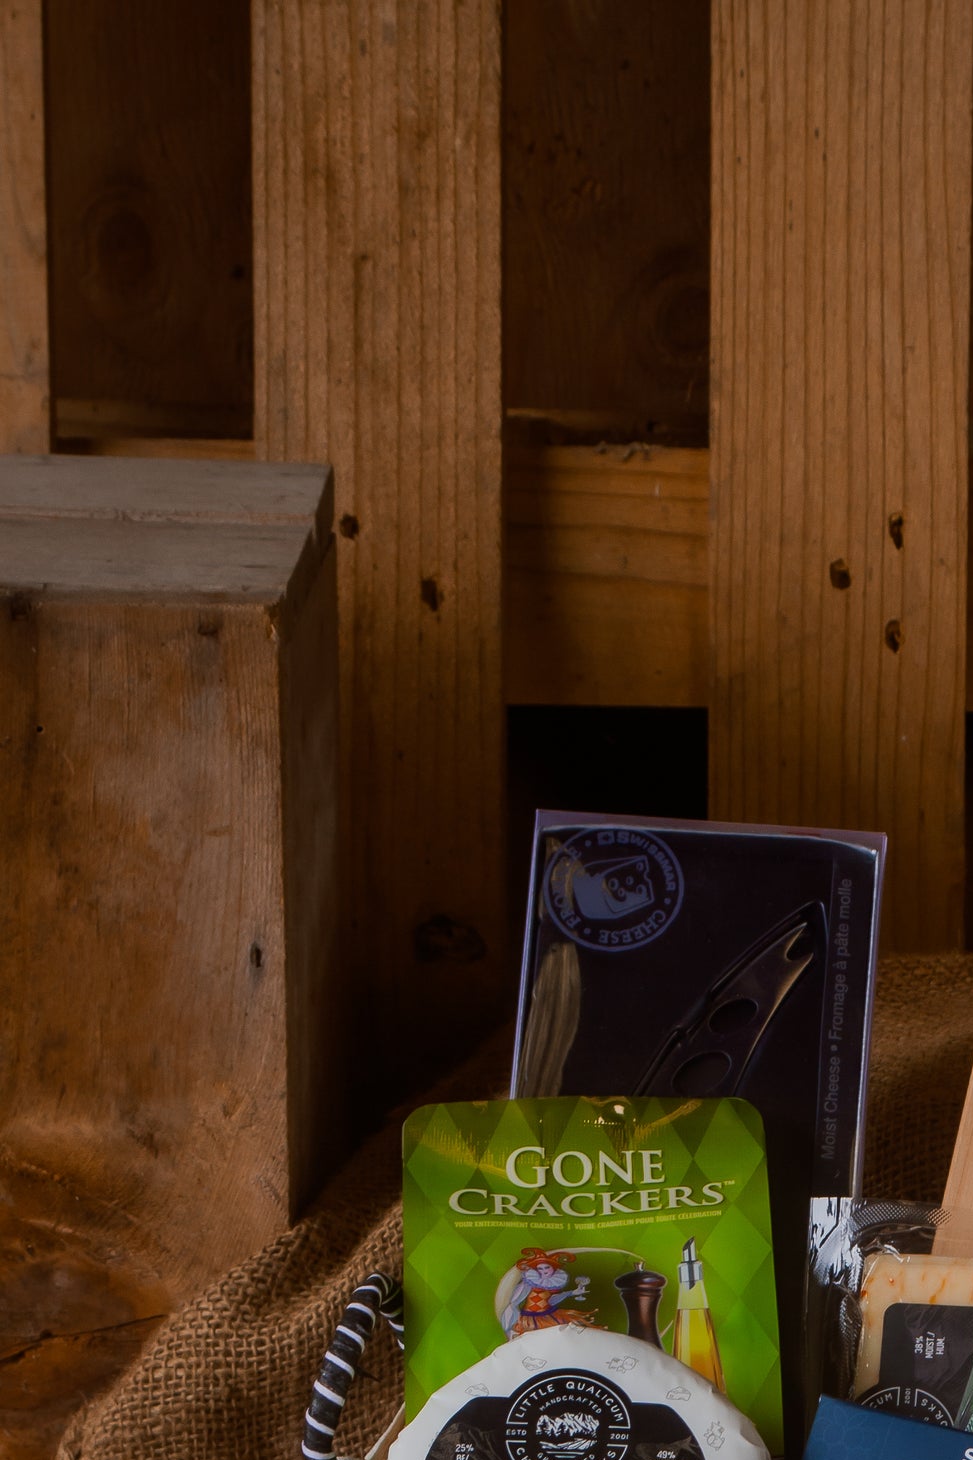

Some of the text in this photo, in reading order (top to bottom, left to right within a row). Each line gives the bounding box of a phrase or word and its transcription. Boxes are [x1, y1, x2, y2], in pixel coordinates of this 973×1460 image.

[839, 878, 853, 920] molle
[598, 909, 667, 944] CHEESE
[828, 973, 849, 1041] Fromage
[823, 1056, 841, 1113] Cheese
[820, 1117, 838, 1160] Moist
[505, 1146, 666, 1189] GONE
[515, 1381, 624, 1422] LITTLE QUALICUM
[539, 1394, 602, 1414] HANDCRAFTED
[455, 1444, 474, 1453] 25%
[656, 1450, 676, 1459] 49%
